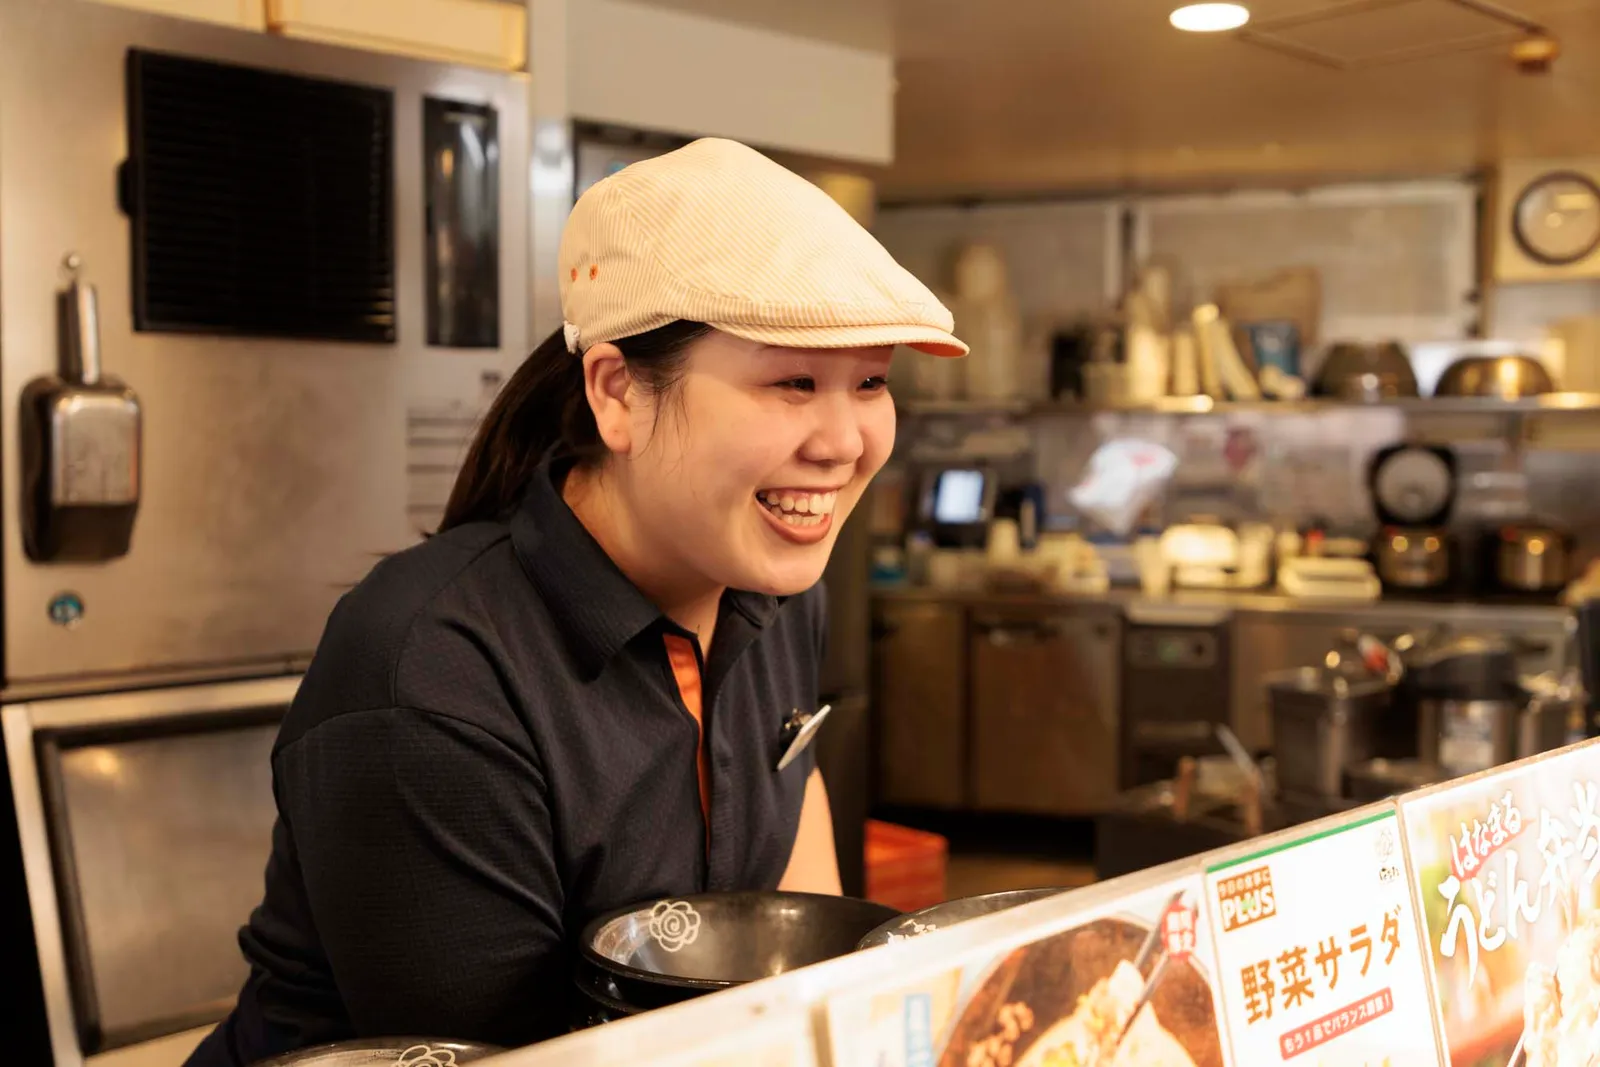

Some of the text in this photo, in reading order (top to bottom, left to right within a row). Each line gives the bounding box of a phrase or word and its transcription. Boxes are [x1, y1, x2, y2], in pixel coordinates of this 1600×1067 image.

[1449, 788, 1521, 877] はなまる
[1222, 885, 1274, 928] PLUS
[1240, 903, 1402, 1025] 野菜サラダ
